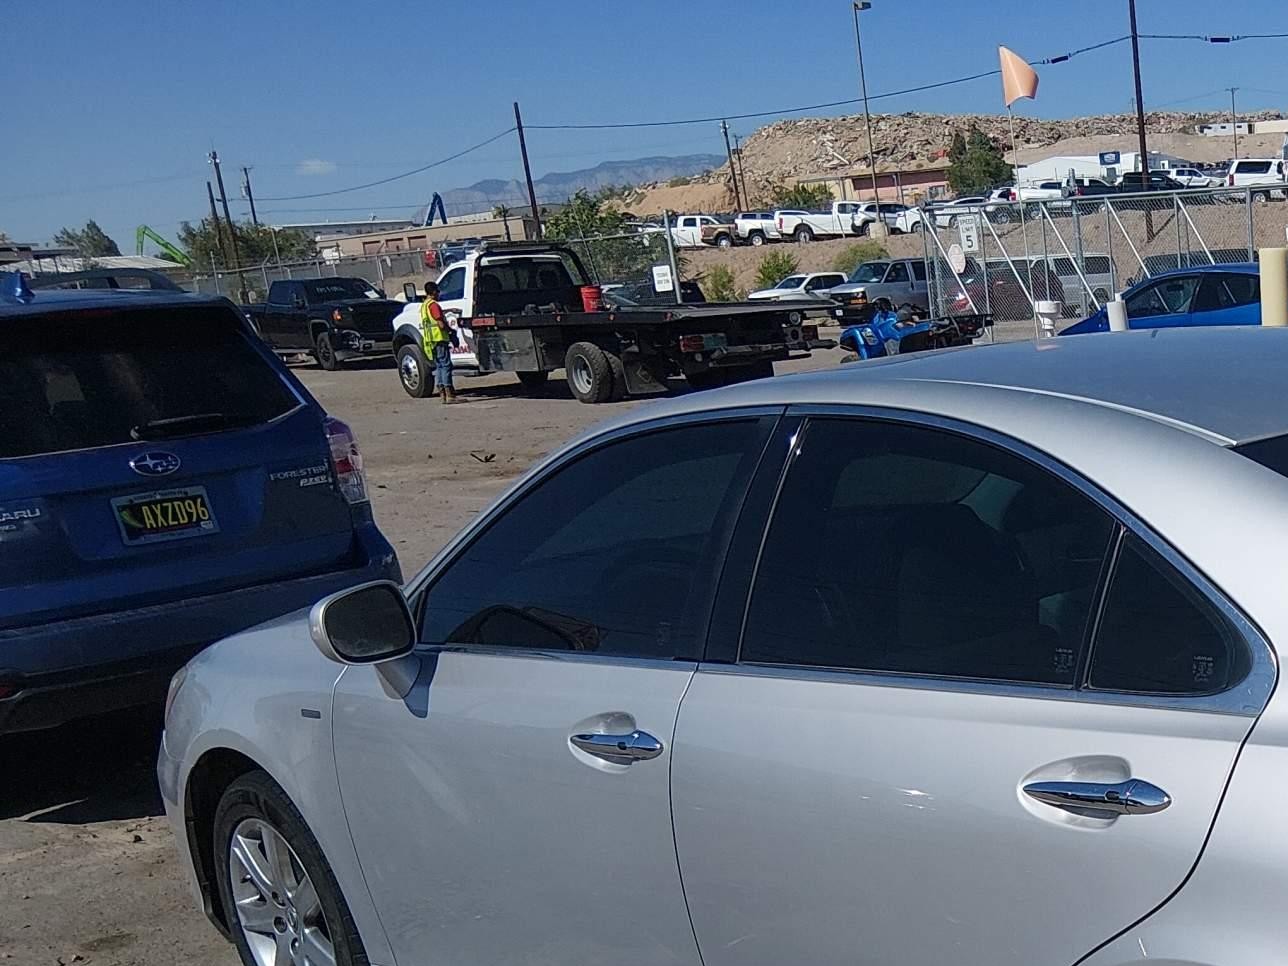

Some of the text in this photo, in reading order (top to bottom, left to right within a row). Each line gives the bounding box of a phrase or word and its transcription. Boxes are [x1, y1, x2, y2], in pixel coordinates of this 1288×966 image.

[965, 235, 974, 249] 5
[270, 465, 327, 480] FORESTER
[0, 508, 41, 521] ARU
[142, 498, 209, 529] AXZD96
